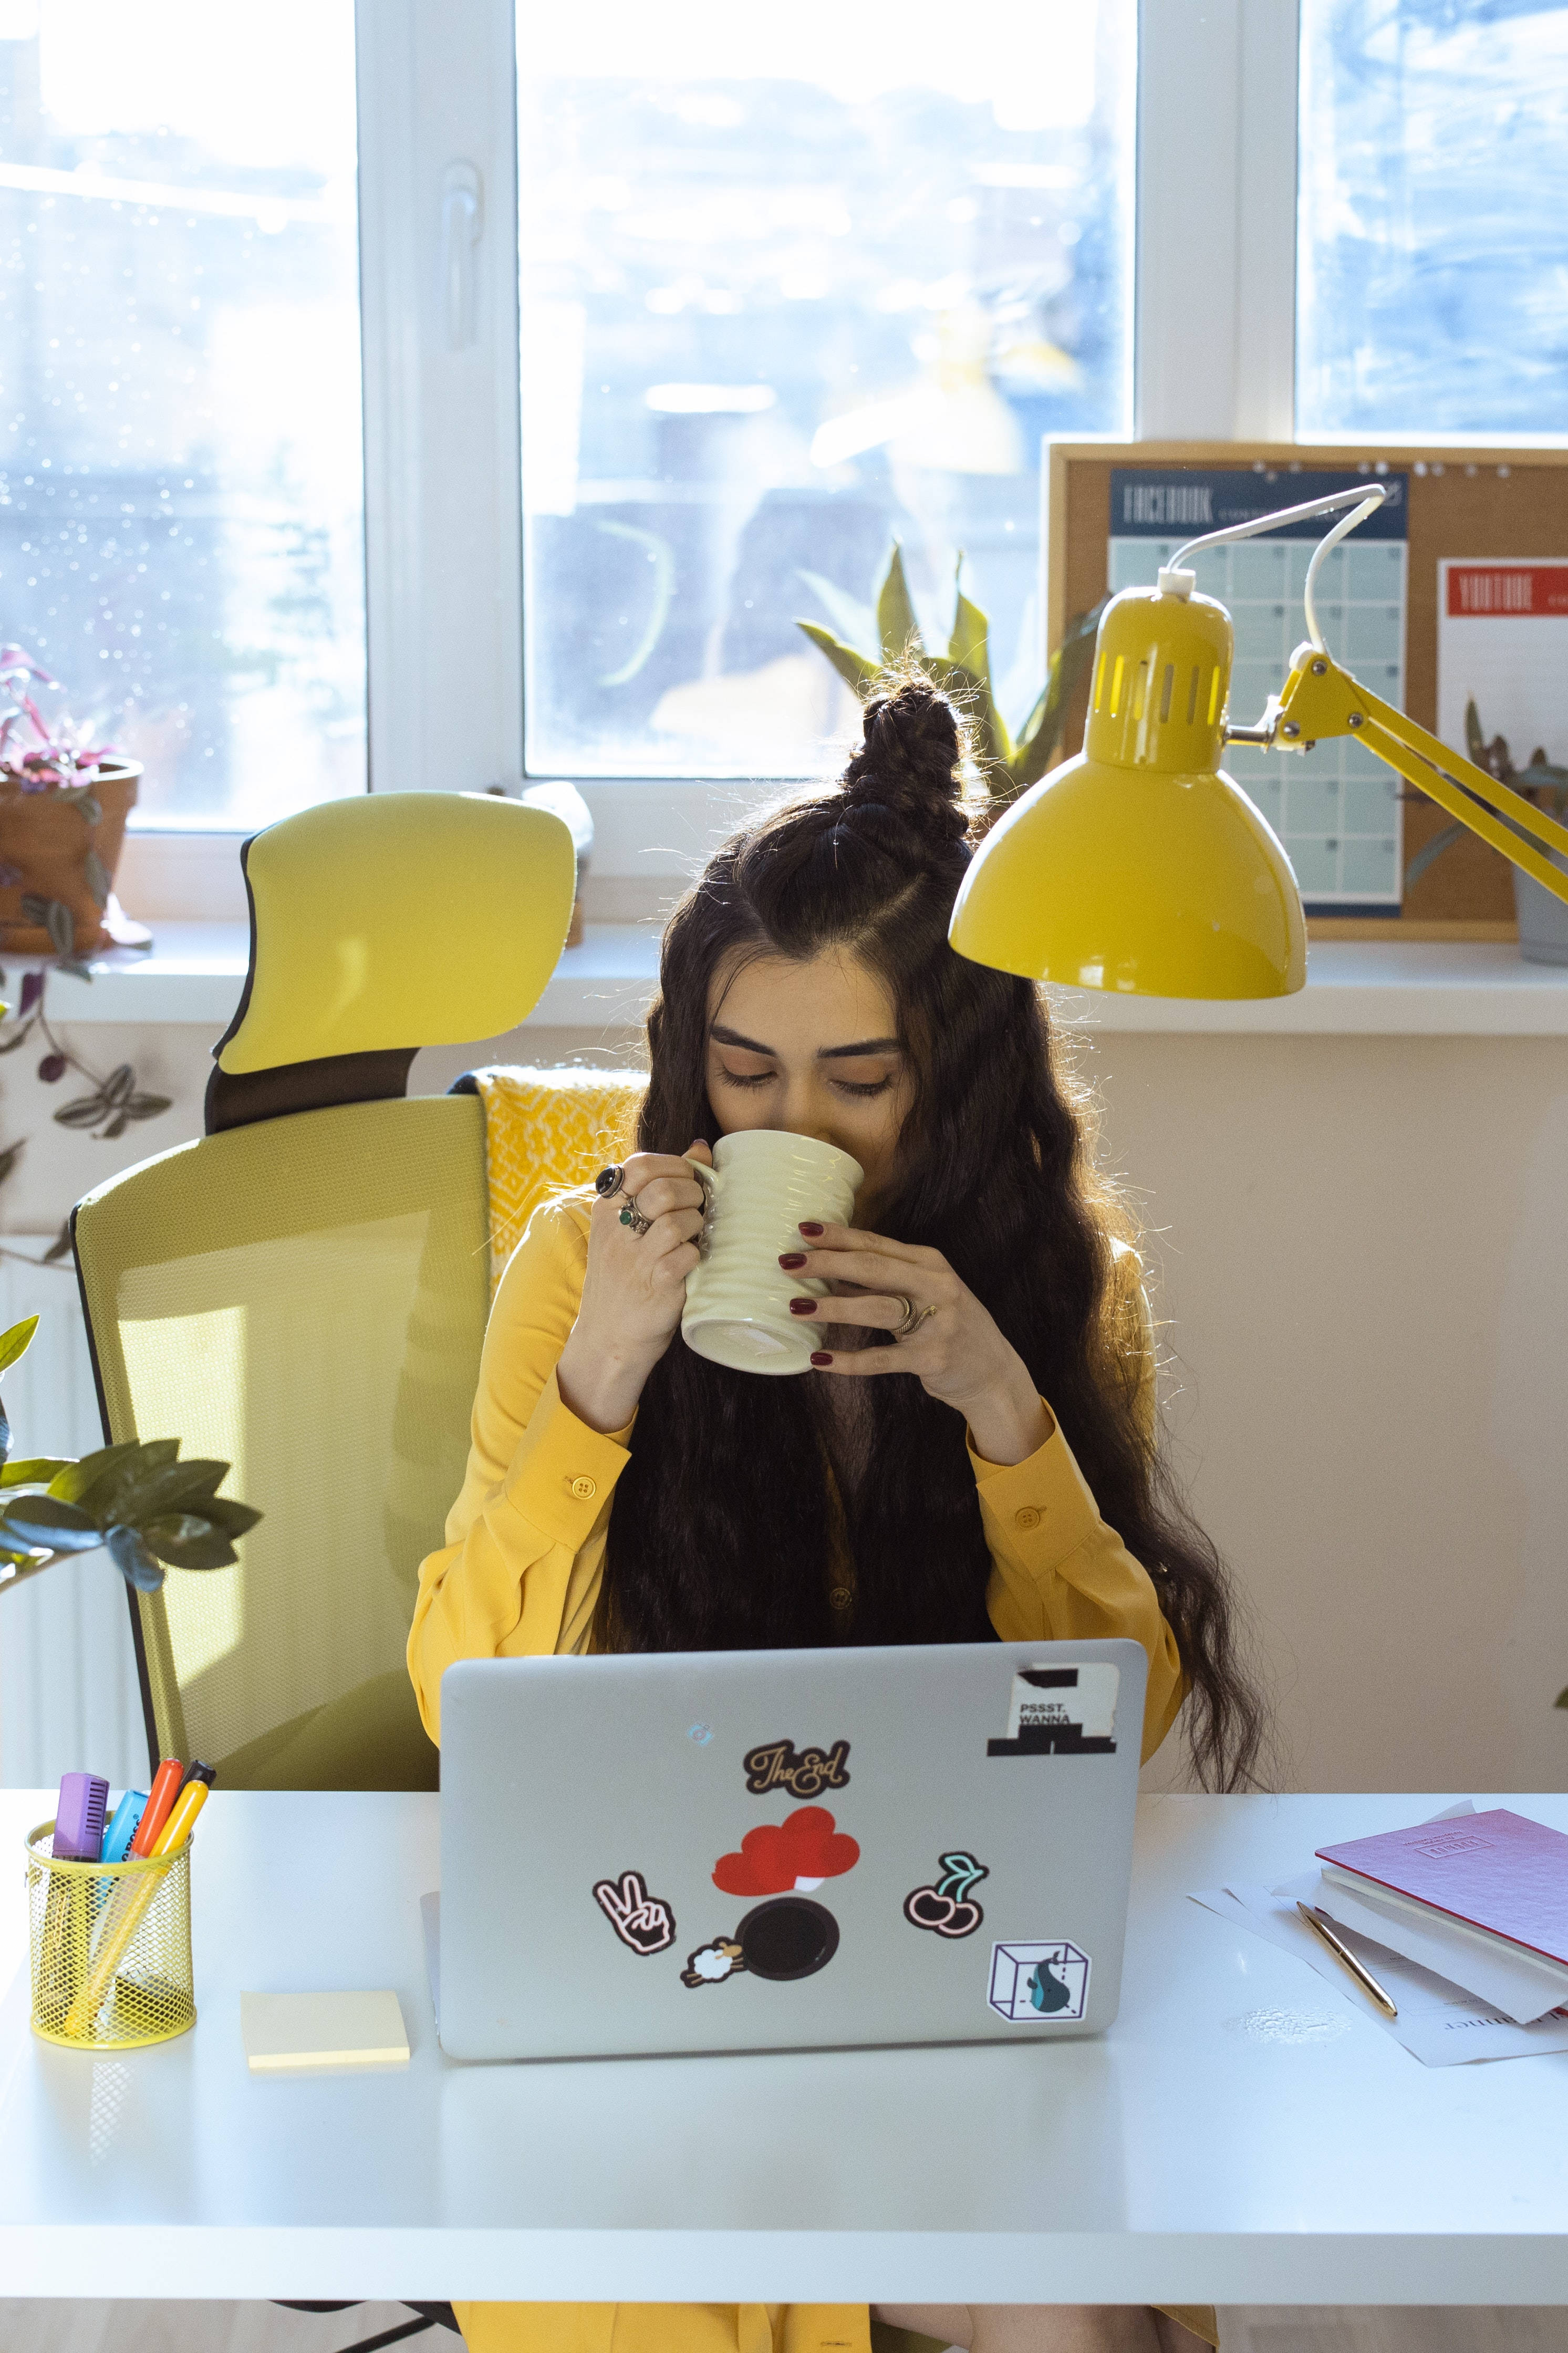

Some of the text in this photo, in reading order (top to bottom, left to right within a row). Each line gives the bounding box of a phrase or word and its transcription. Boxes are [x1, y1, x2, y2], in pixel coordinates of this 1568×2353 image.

[1020, 1703, 1066, 1713] PSSST.
[1020, 1715, 1071, 1725] WANNA
[750, 1745, 844, 1794] The End
